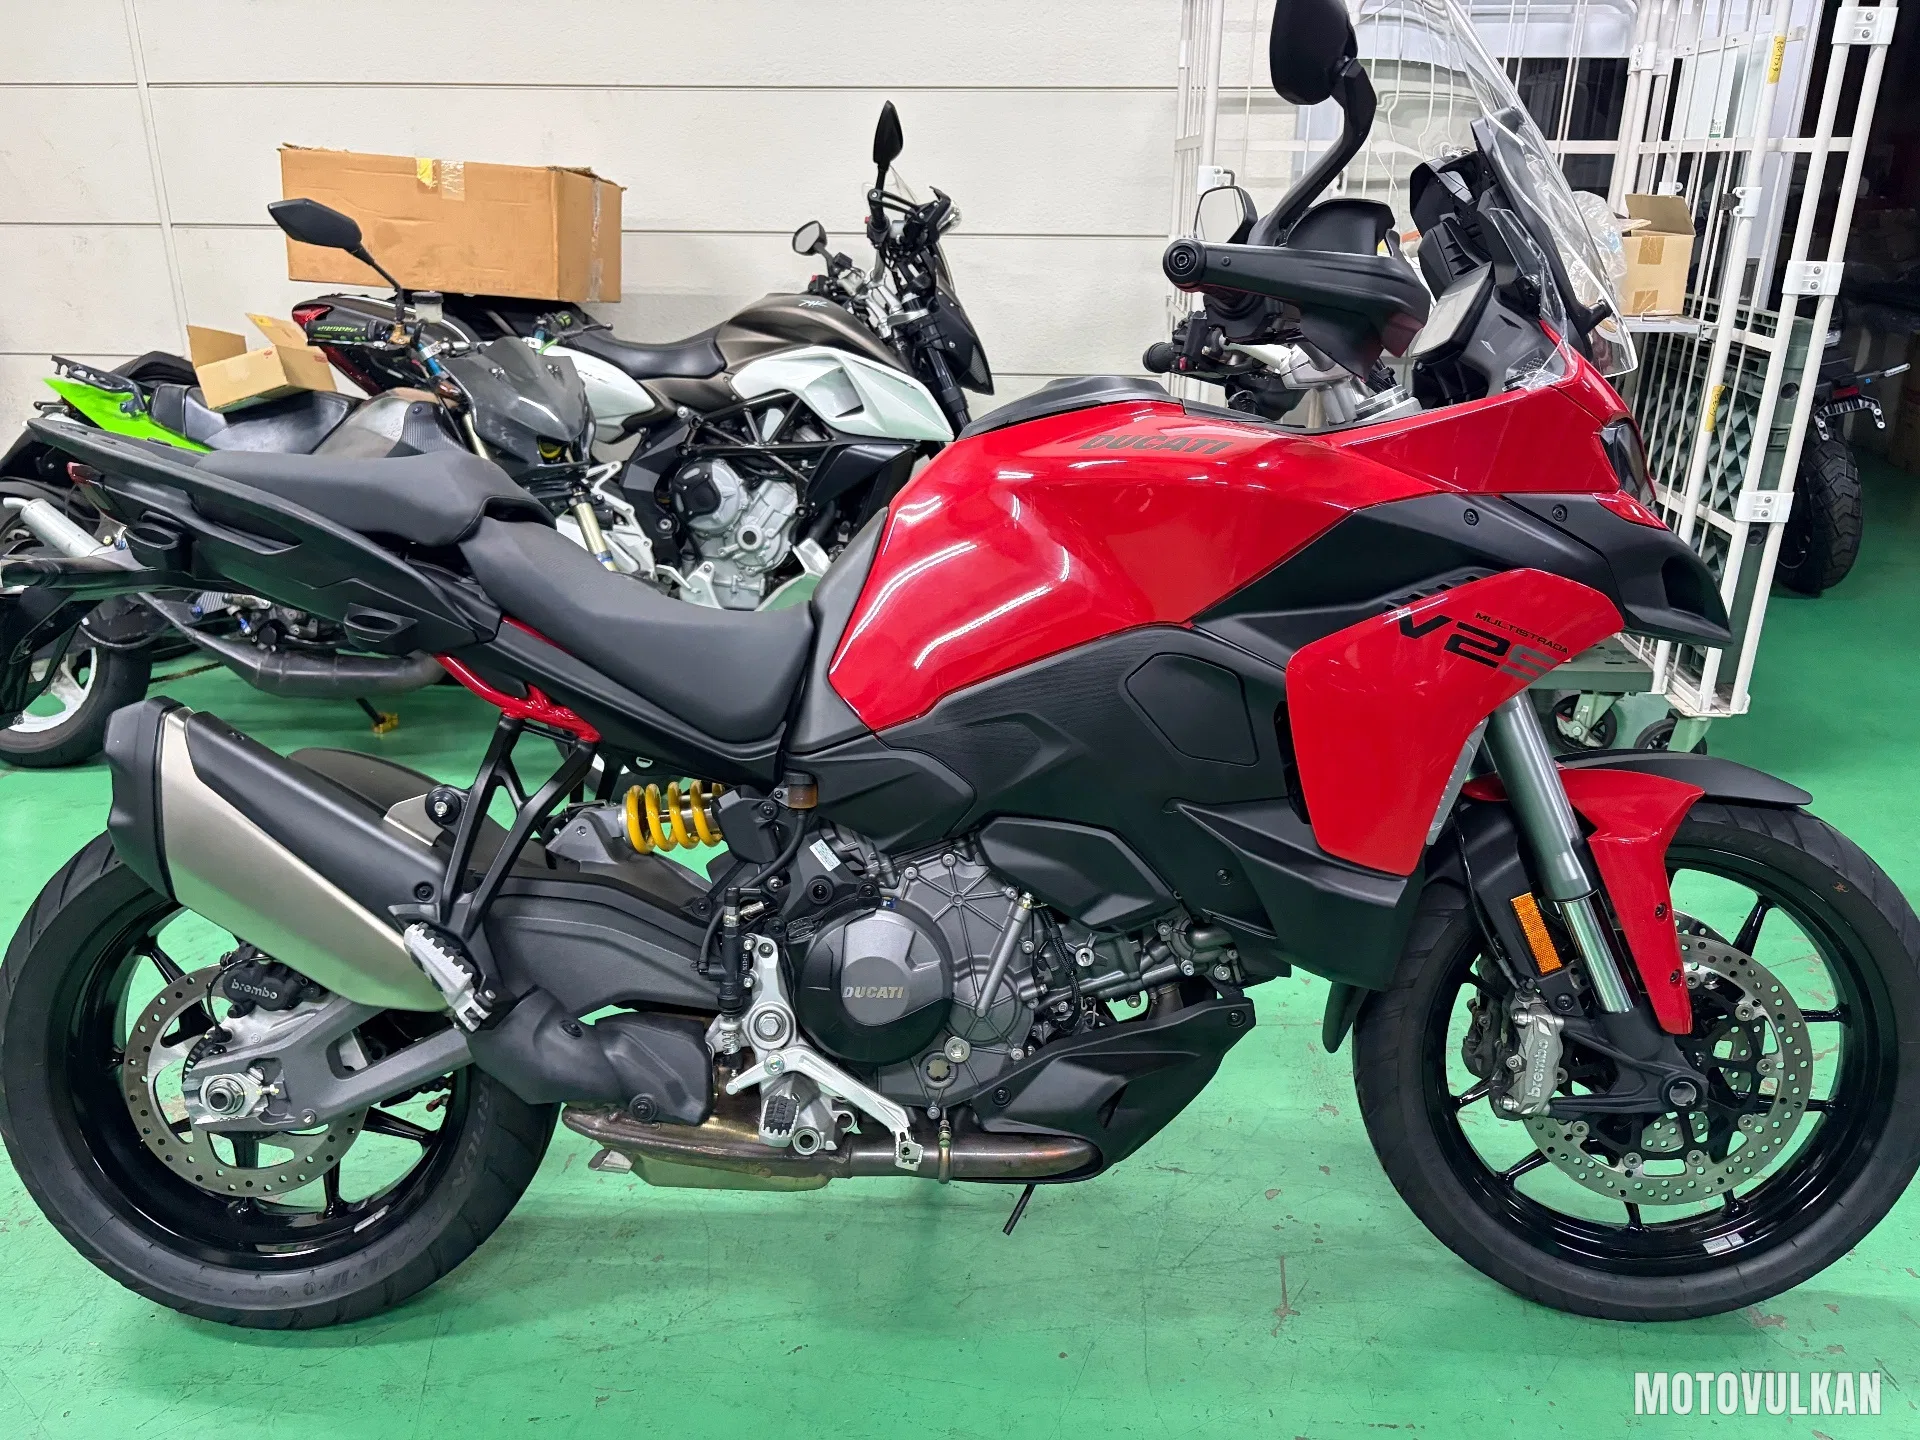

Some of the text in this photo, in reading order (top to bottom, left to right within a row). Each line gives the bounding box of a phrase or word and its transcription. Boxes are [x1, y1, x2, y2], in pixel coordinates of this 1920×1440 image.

[1077, 434, 1234, 455] DUCATI
[1475, 612, 1568, 654] MULTISTRADA
[231, 978, 278, 1000] brembo
[842, 986, 904, 999] DUCATI
[1526, 1039, 1549, 1098] brembo
